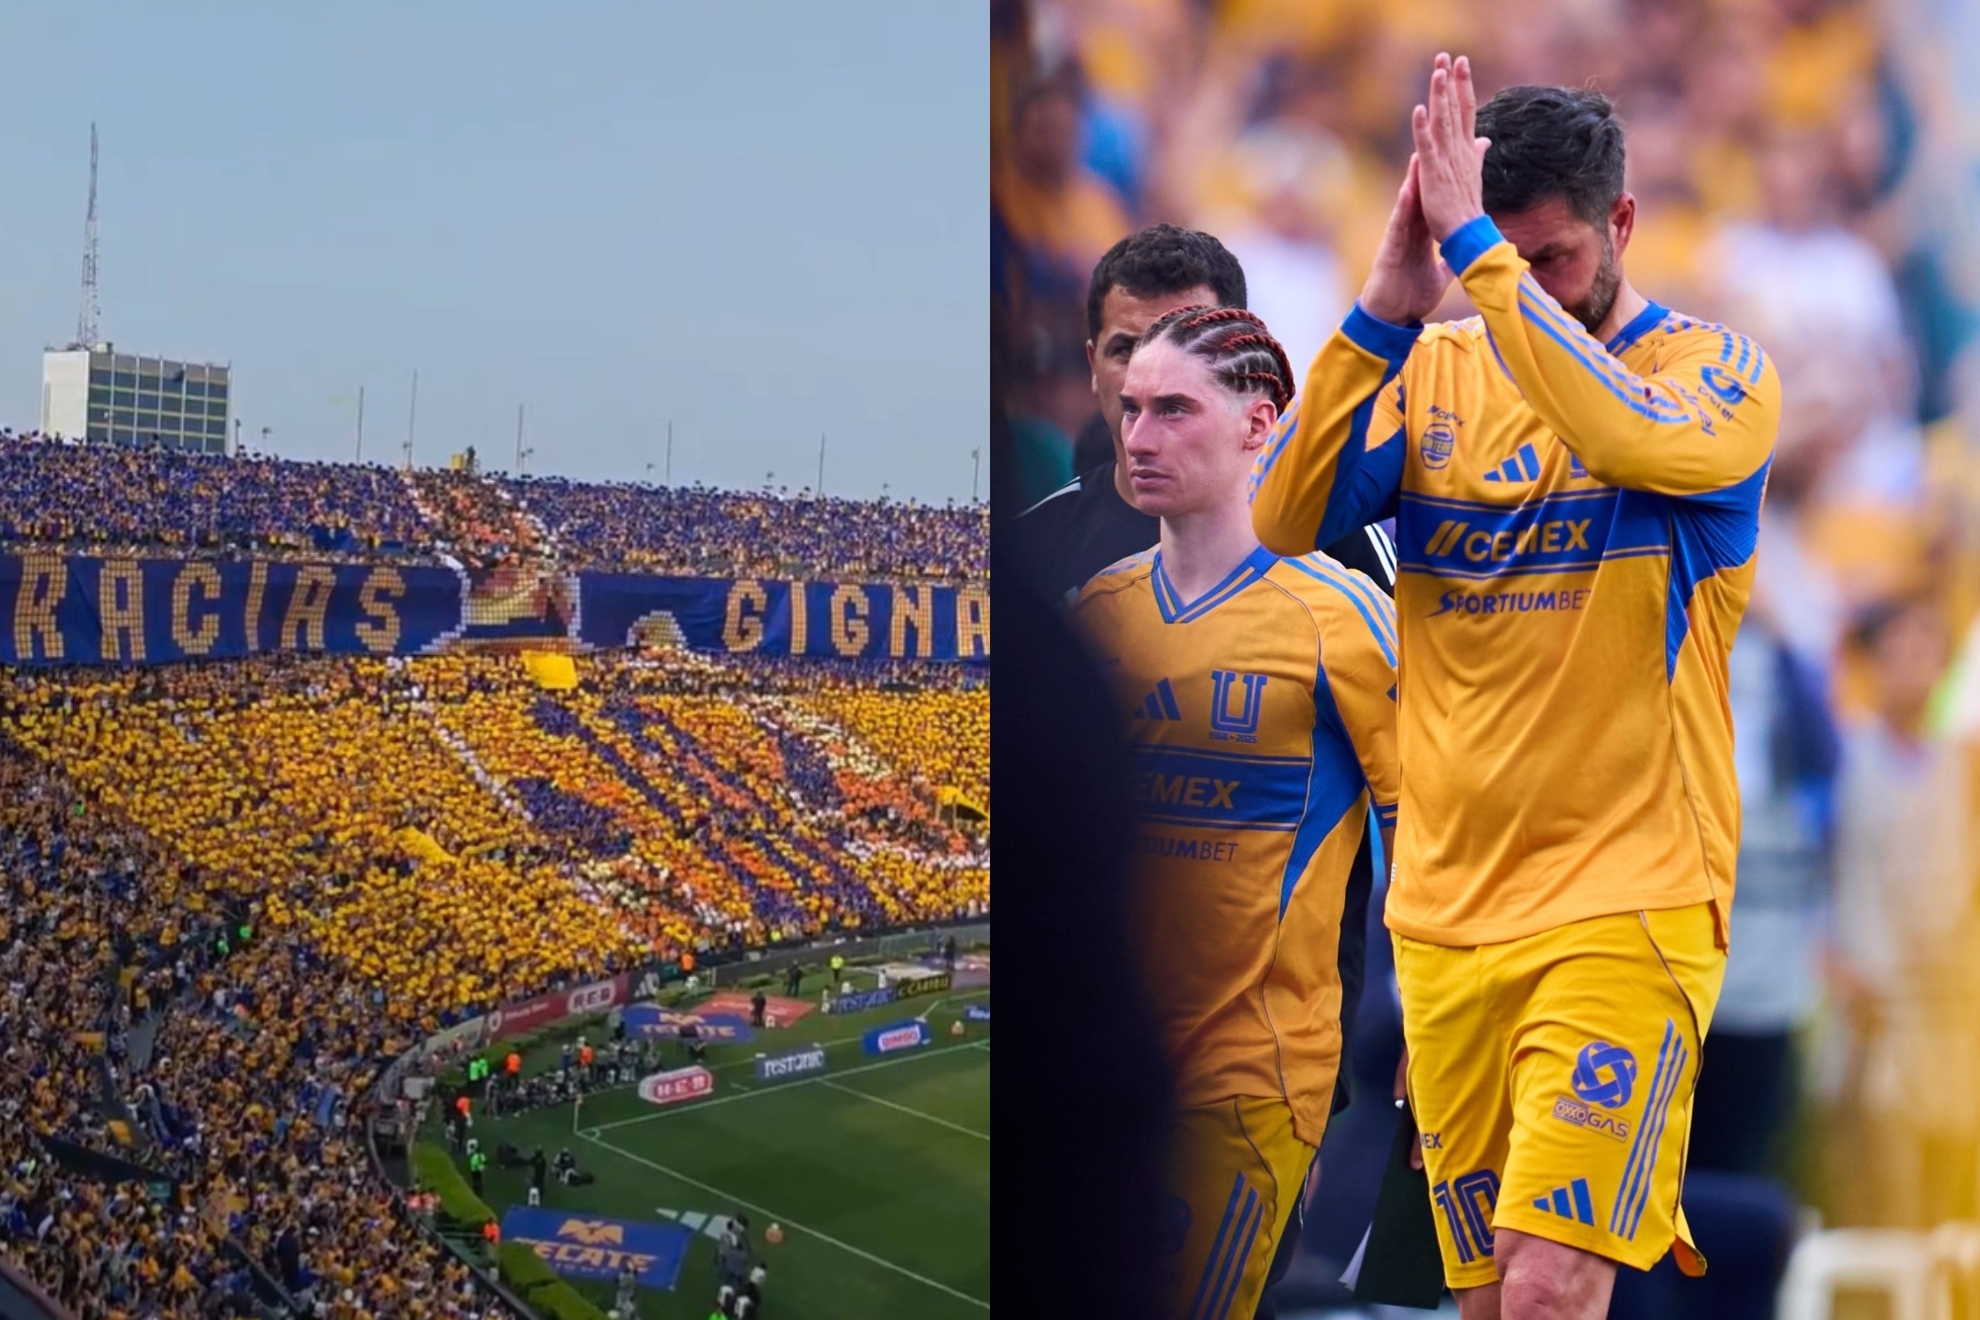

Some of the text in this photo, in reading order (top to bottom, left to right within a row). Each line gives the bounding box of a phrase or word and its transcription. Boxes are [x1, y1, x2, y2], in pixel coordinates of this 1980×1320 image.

[14, 555, 990, 661] RACIAS GIGNA
[1555, 1102, 1629, 1138] OXXO GAS
[1433, 1168, 1501, 1264] 10
